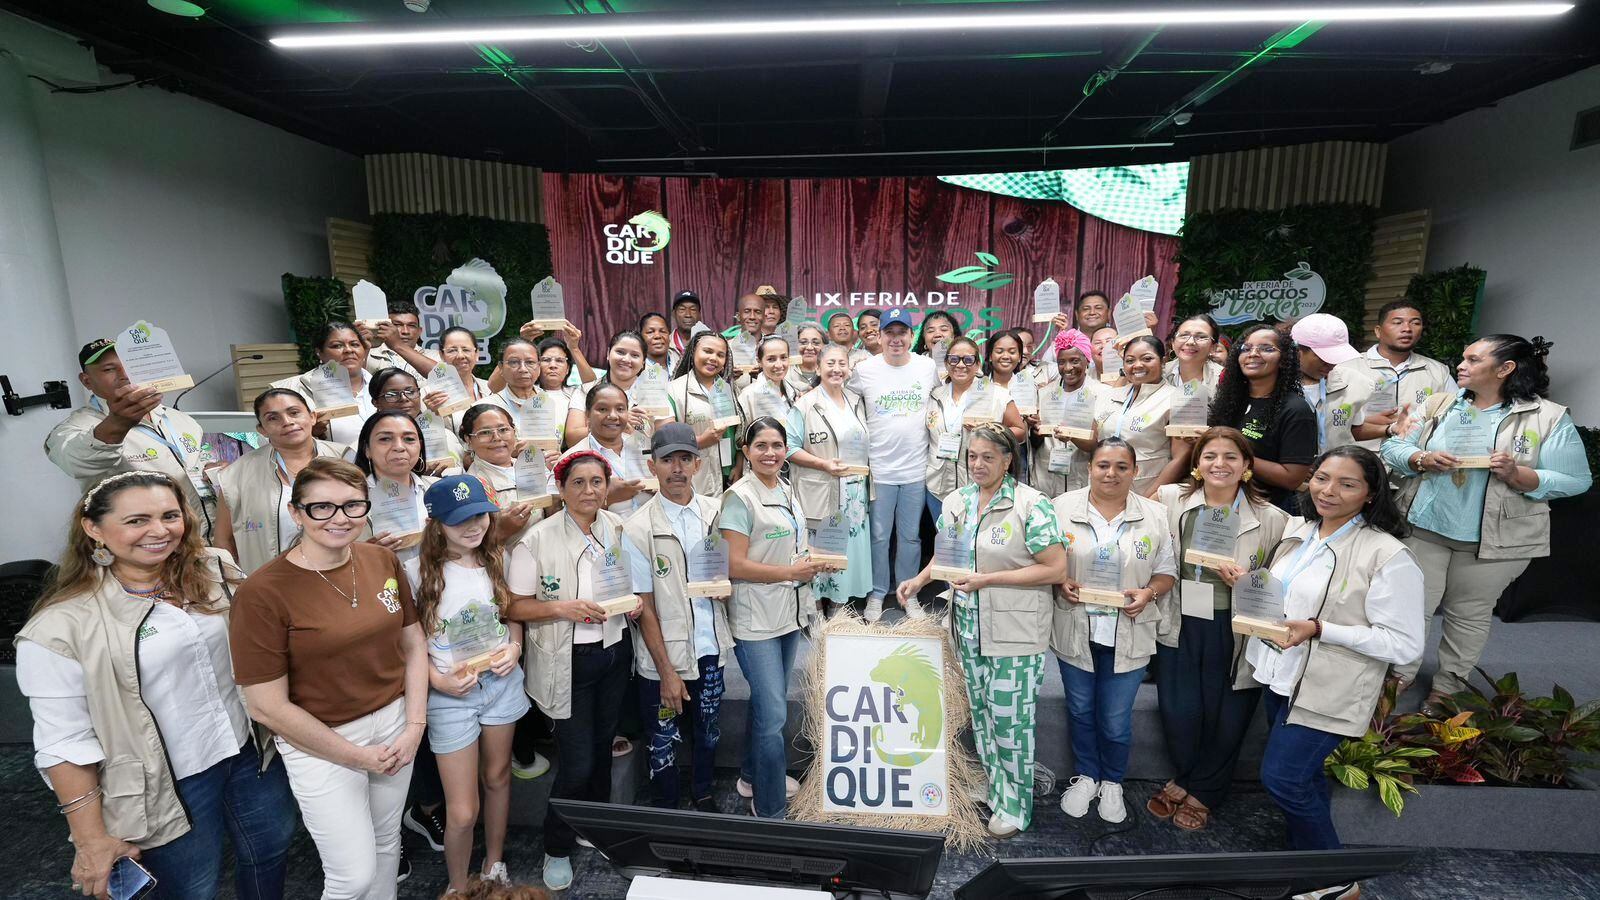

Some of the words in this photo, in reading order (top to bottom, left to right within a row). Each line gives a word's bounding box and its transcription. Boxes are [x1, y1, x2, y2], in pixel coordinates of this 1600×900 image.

[604, 224, 651, 238] CAR
[607, 238, 632, 250] DI
[606, 250, 654, 264] QUE
[417, 288, 480, 312] CAR
[815, 292, 842, 306] IX
[850, 292, 919, 306] FERIA
[928, 292, 960, 306] DE
[1222, 288, 1308, 301] NEGOCIOS
[1229, 298, 1301, 320] Verdes
[424, 314, 455, 338] DI
[826, 685, 908, 724] CAR
[830, 725, 871, 764] DI
[826, 766, 913, 808] QUE
